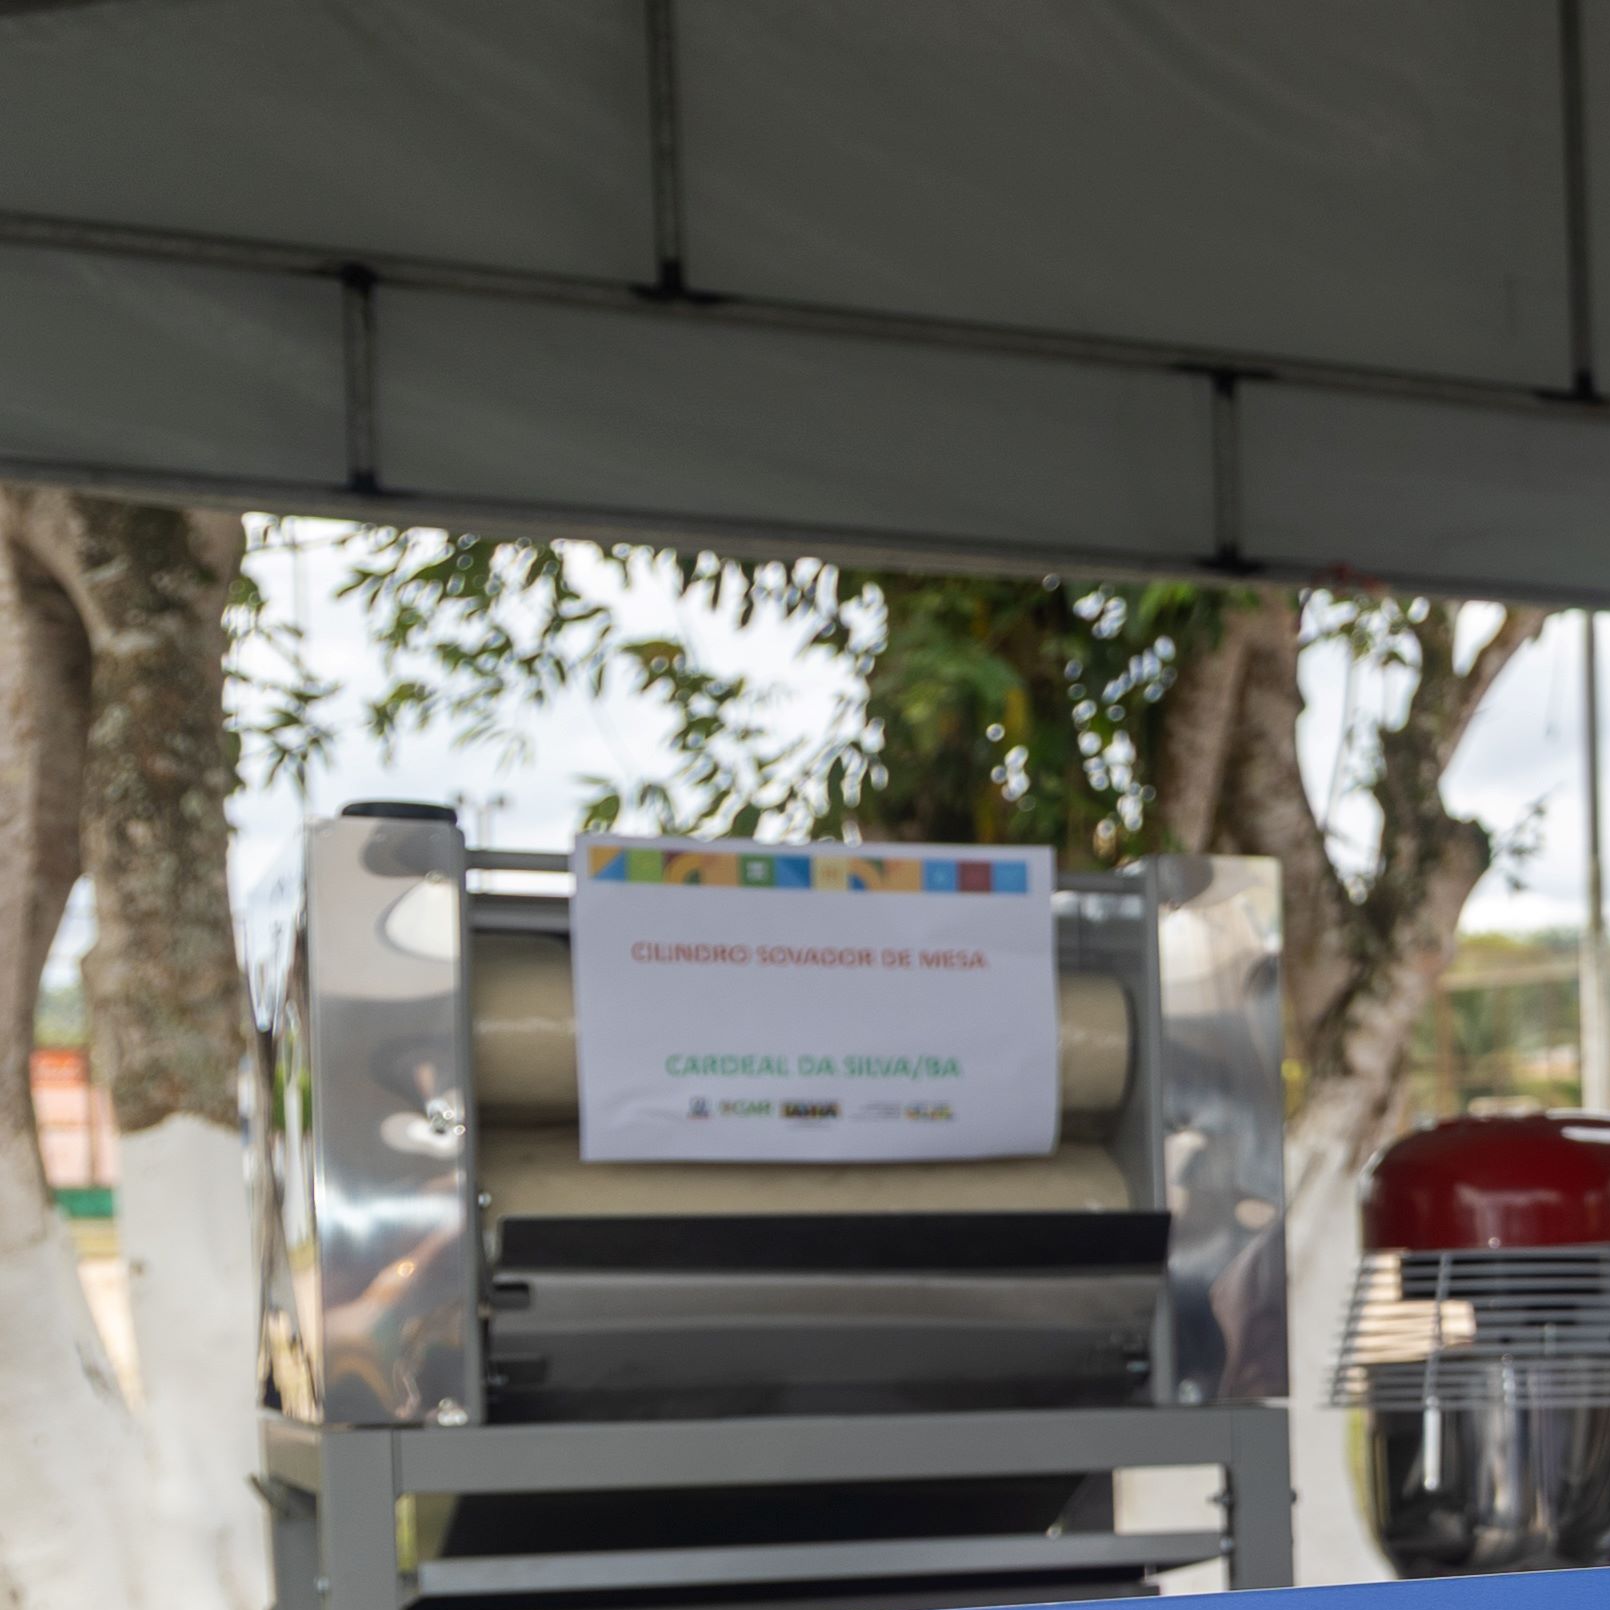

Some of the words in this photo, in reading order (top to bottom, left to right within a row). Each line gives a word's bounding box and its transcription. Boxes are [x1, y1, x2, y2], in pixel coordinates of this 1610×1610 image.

[631, 942, 750, 964] CILINDRO
[757, 945, 872, 967] SOVADOR
[883, 948, 911, 968] DE
[920, 949, 988, 970] MESA
[666, 1053, 789, 1077] CARDEAL
[799, 1055, 835, 1077] DA
[843, 1055, 961, 1080] SILVA/BA
